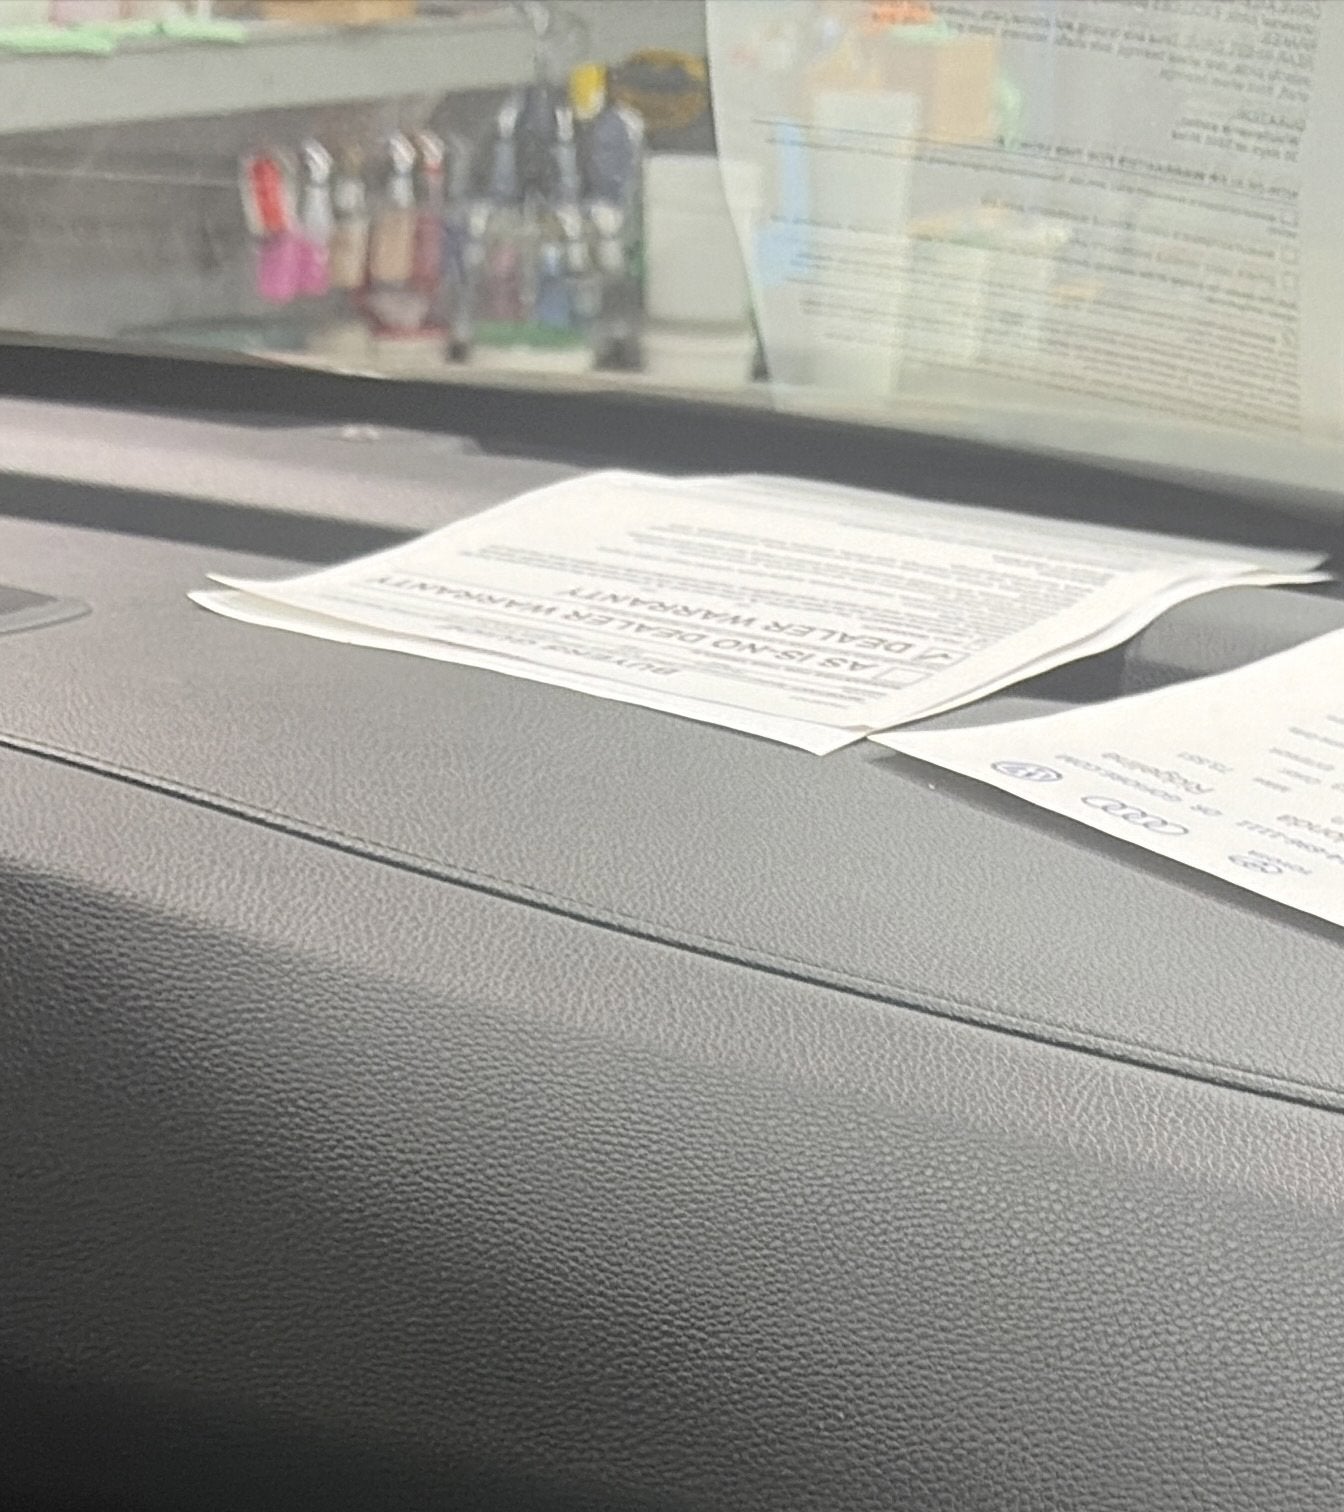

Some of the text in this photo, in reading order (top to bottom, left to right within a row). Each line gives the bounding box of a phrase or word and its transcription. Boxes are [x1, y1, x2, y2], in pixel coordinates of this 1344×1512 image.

[365, 572, 875, 675] AS IS-NO DEALER WARRANTY
[554, 586, 915, 656] DEALER WARRANTY
[1101, 753, 1214, 795] Ridgeline
